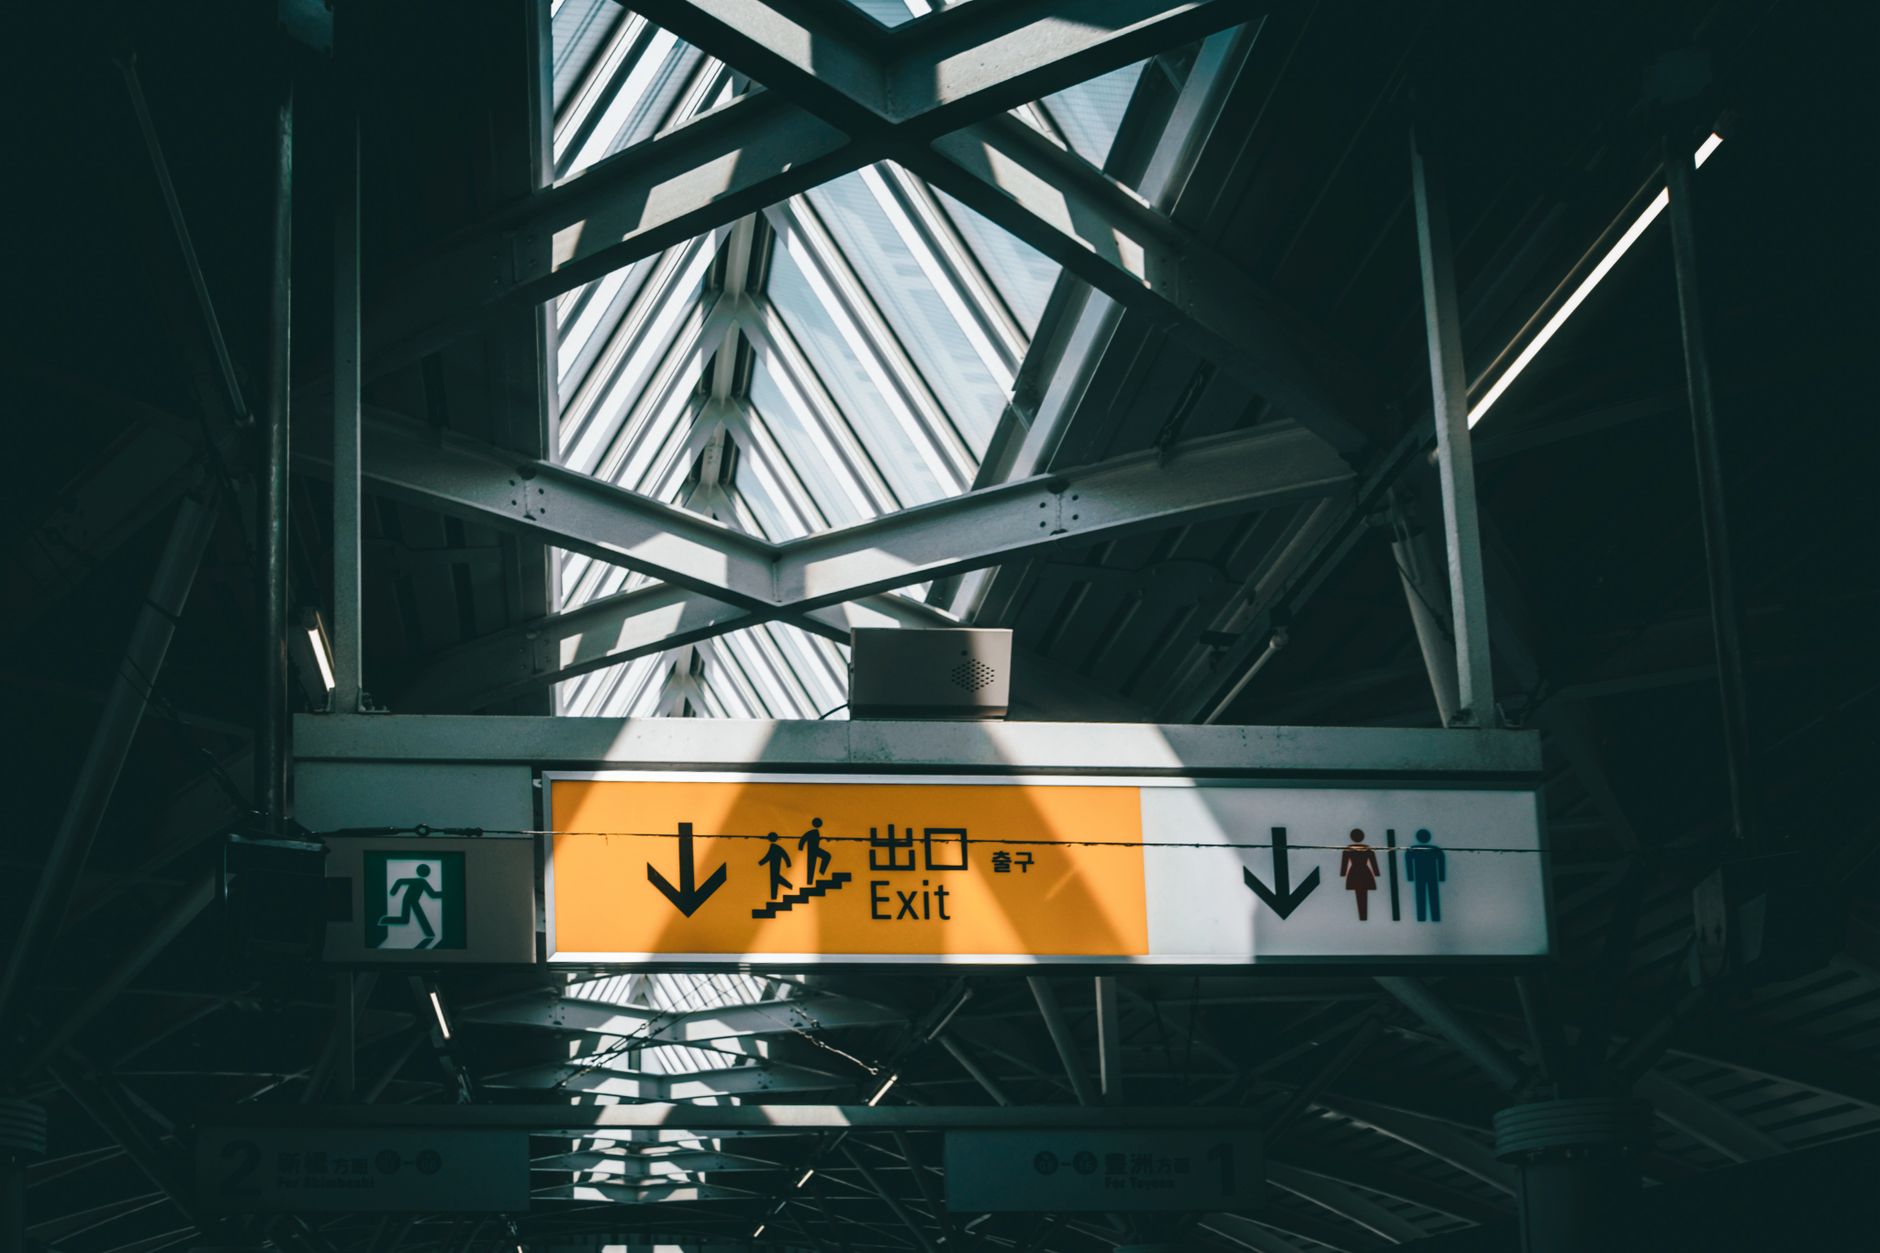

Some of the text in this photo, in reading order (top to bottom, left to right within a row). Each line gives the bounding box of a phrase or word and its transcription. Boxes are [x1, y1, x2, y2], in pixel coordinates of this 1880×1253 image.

[869, 824, 968, 871] 出口
[992, 850, 1035, 873] 출구
[870, 879, 951, 921] Exit
[220, 1139, 262, 1197] 2
[1207, 1142, 1236, 1197] 1
